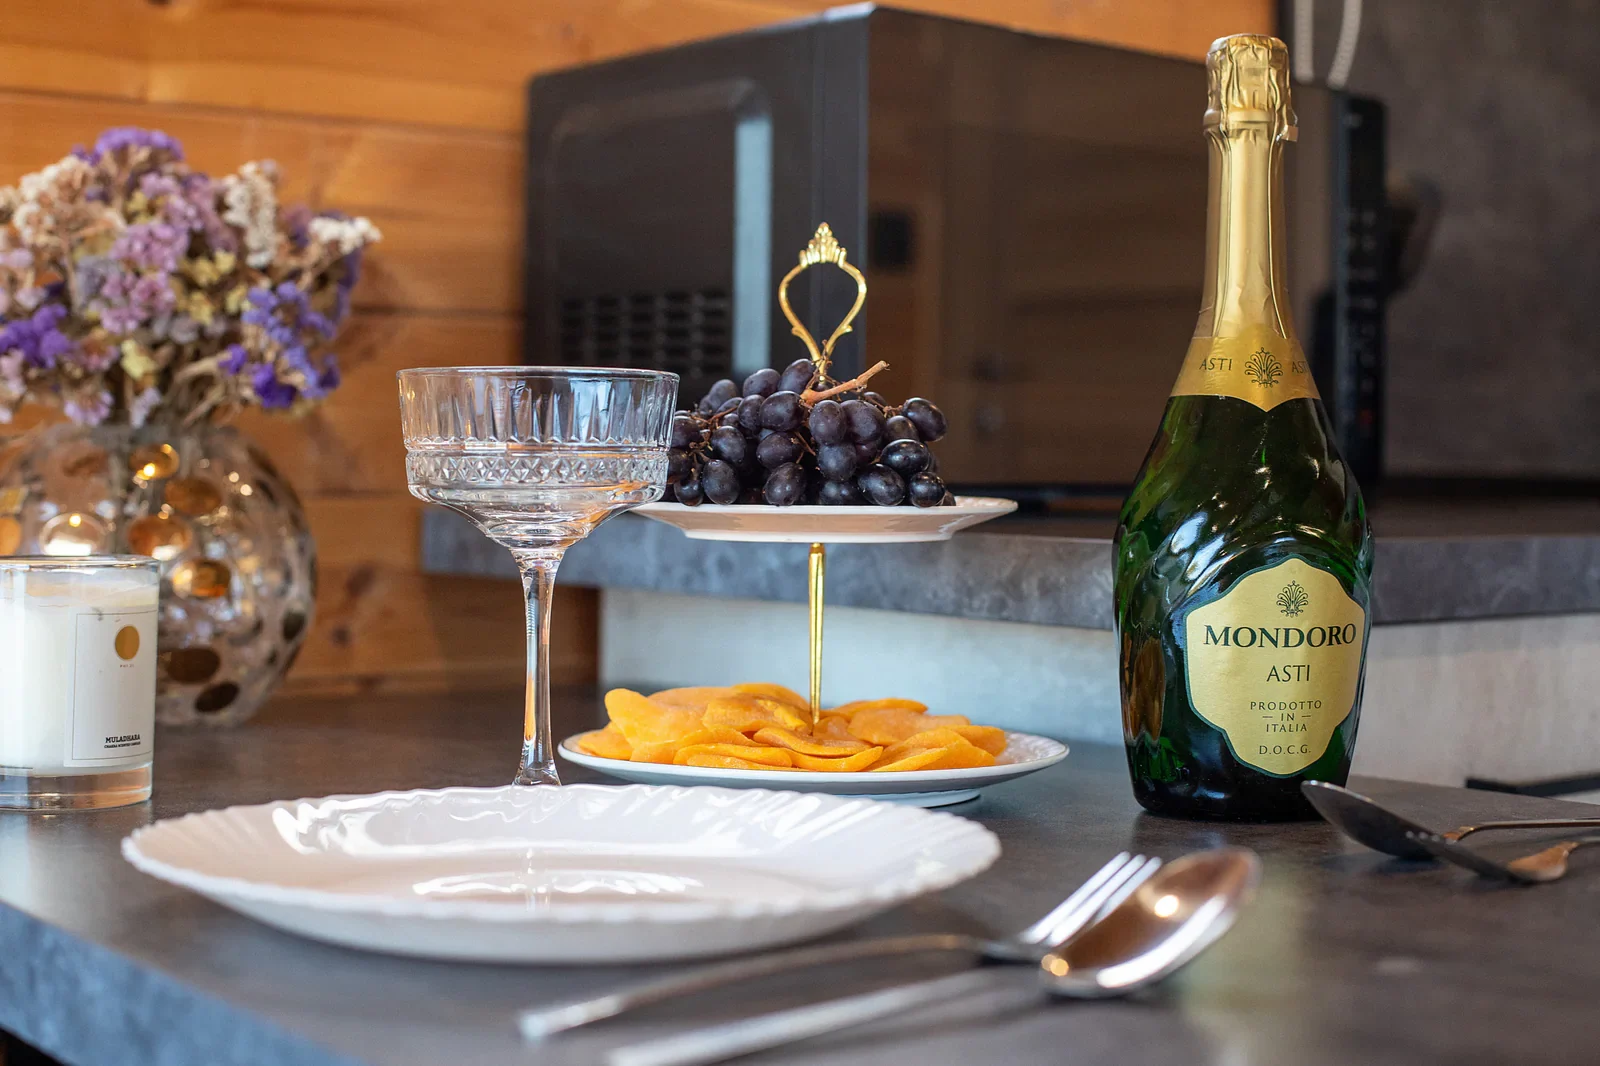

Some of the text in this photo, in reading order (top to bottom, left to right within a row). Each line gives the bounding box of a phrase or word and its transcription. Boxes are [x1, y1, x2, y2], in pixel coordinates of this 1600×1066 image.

[1199, 357, 1309, 374] ASTI AST
[1203, 623, 1357, 648] MONDORO
[1266, 664, 1311, 682] ASTI
[1250, 700, 1322, 711] PRODOTTO
[1280, 712, 1295, 721] IN
[1266, 723, 1308, 733] ITALIA
[1259, 744, 1312, 755] D.O.C.G.
